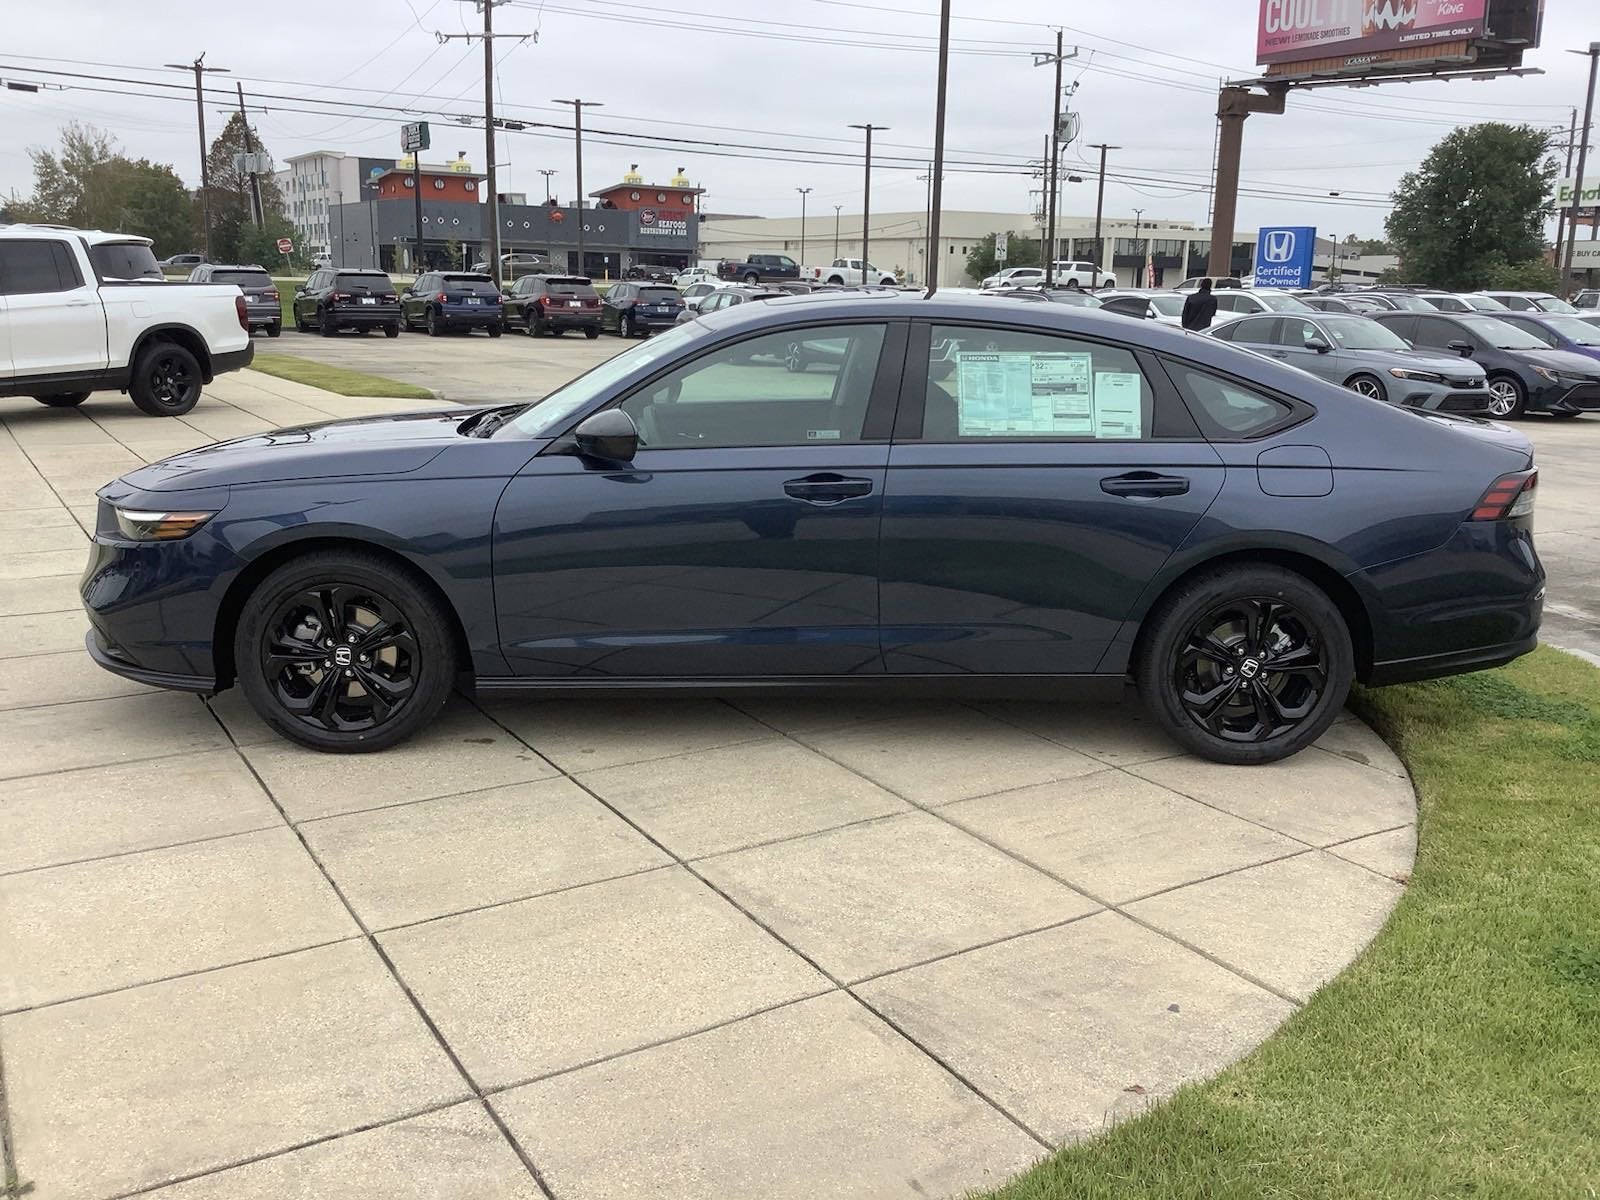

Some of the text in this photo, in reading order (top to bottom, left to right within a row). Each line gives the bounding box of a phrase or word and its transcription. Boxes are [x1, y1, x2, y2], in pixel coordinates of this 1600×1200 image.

[1292, 31, 1319, 43] LEMONADE
[1320, 27, 1350, 39] SMOOTHIES
[1400, 27, 1474, 42] LIMITED TIME ONLY
[658, 220, 687, 229] SEAFOOD
[1256, 265, 1301, 276] Certified
[1255, 277, 1300, 285] Pre-Owned
